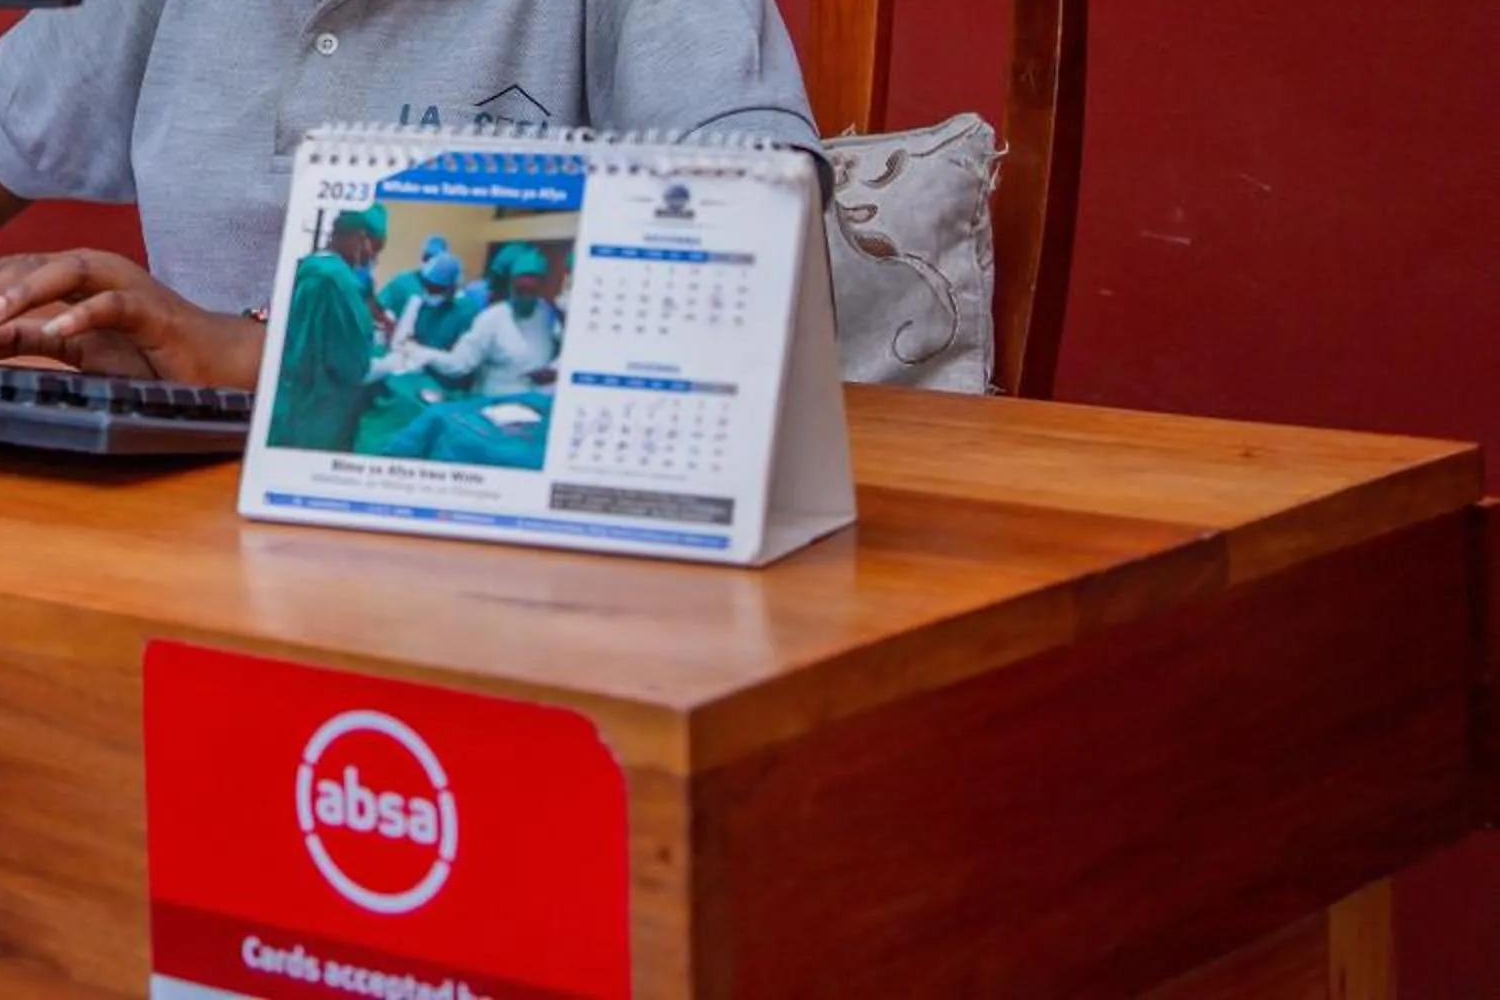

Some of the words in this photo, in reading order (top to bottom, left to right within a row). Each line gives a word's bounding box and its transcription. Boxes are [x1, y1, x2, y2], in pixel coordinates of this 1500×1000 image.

[317, 181, 370, 201] 2023
[315, 765, 439, 845] absa
[242, 935, 321, 983] Cards
[323, 960, 455, 1000] accepted
